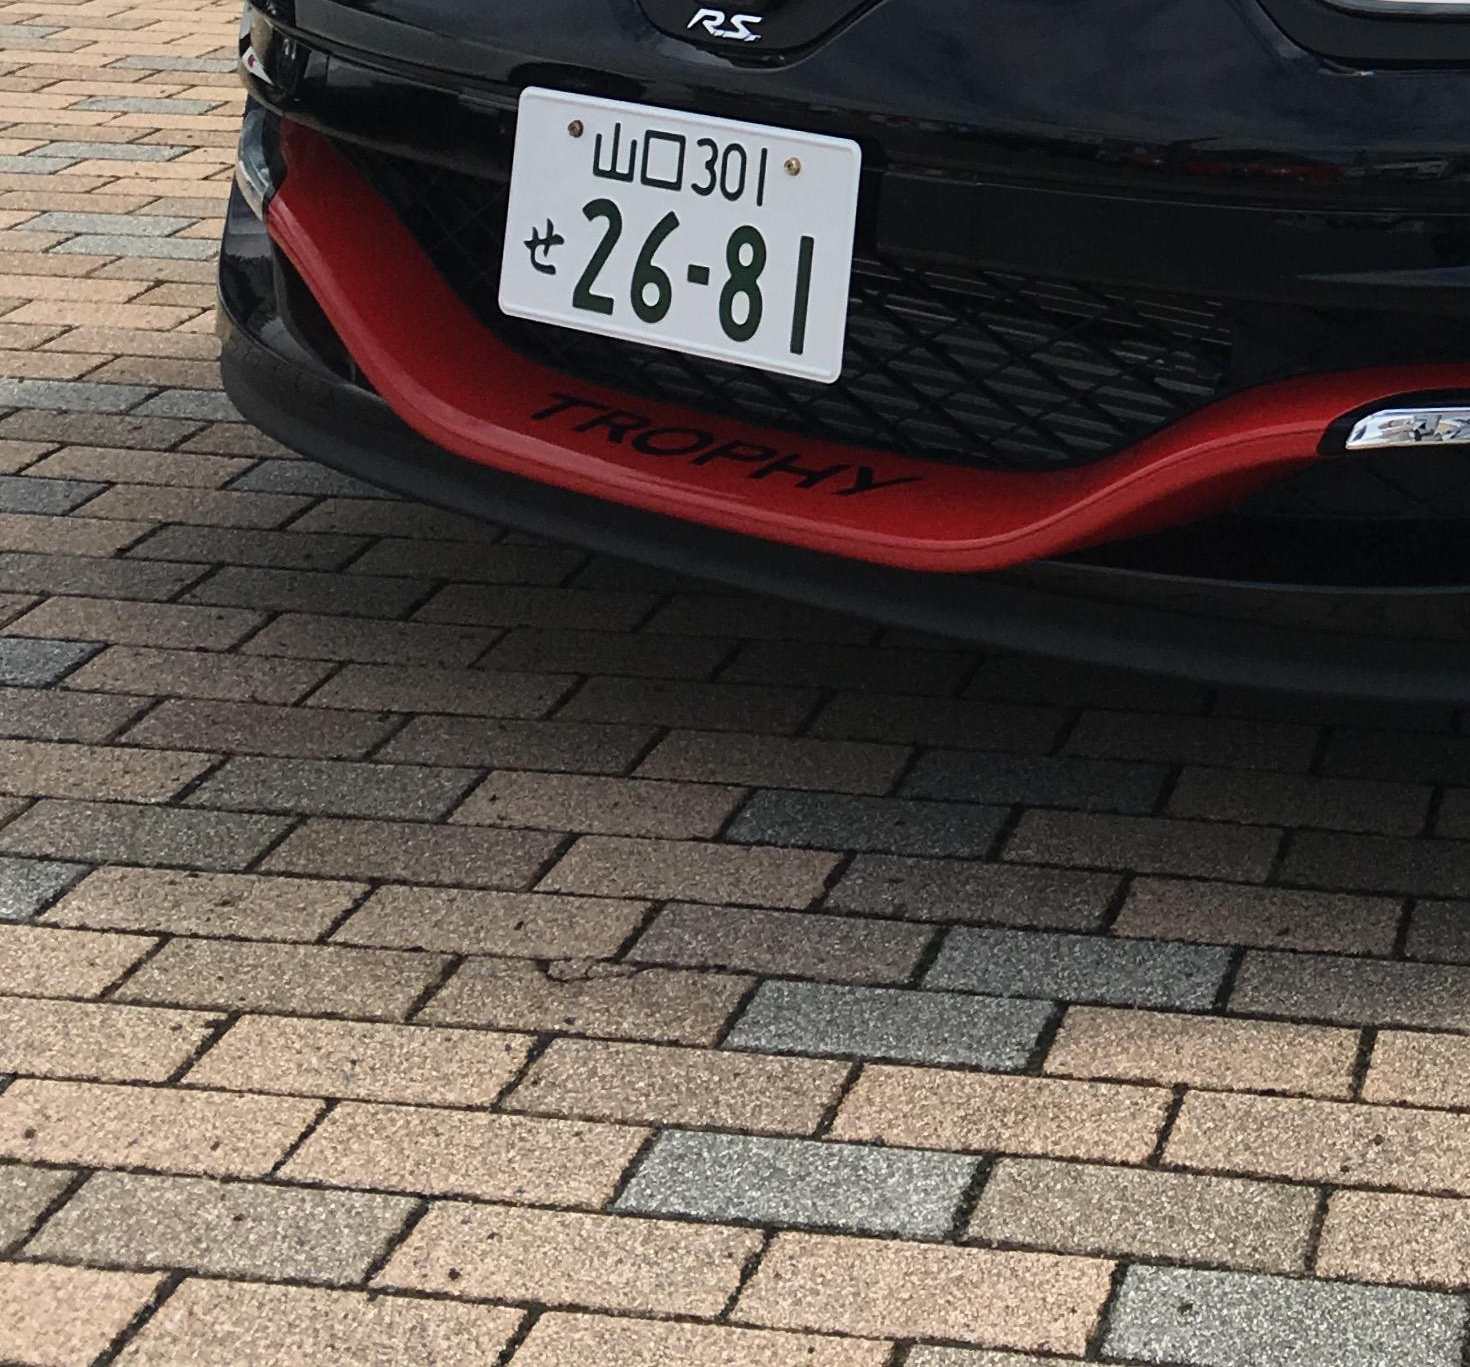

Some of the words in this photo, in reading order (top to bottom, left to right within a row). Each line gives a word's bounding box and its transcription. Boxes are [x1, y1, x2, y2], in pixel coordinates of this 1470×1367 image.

[523, 218, 565, 275] せ
[572, 198, 815, 355] 26-81
[531, 392, 925, 497] TROPHY
